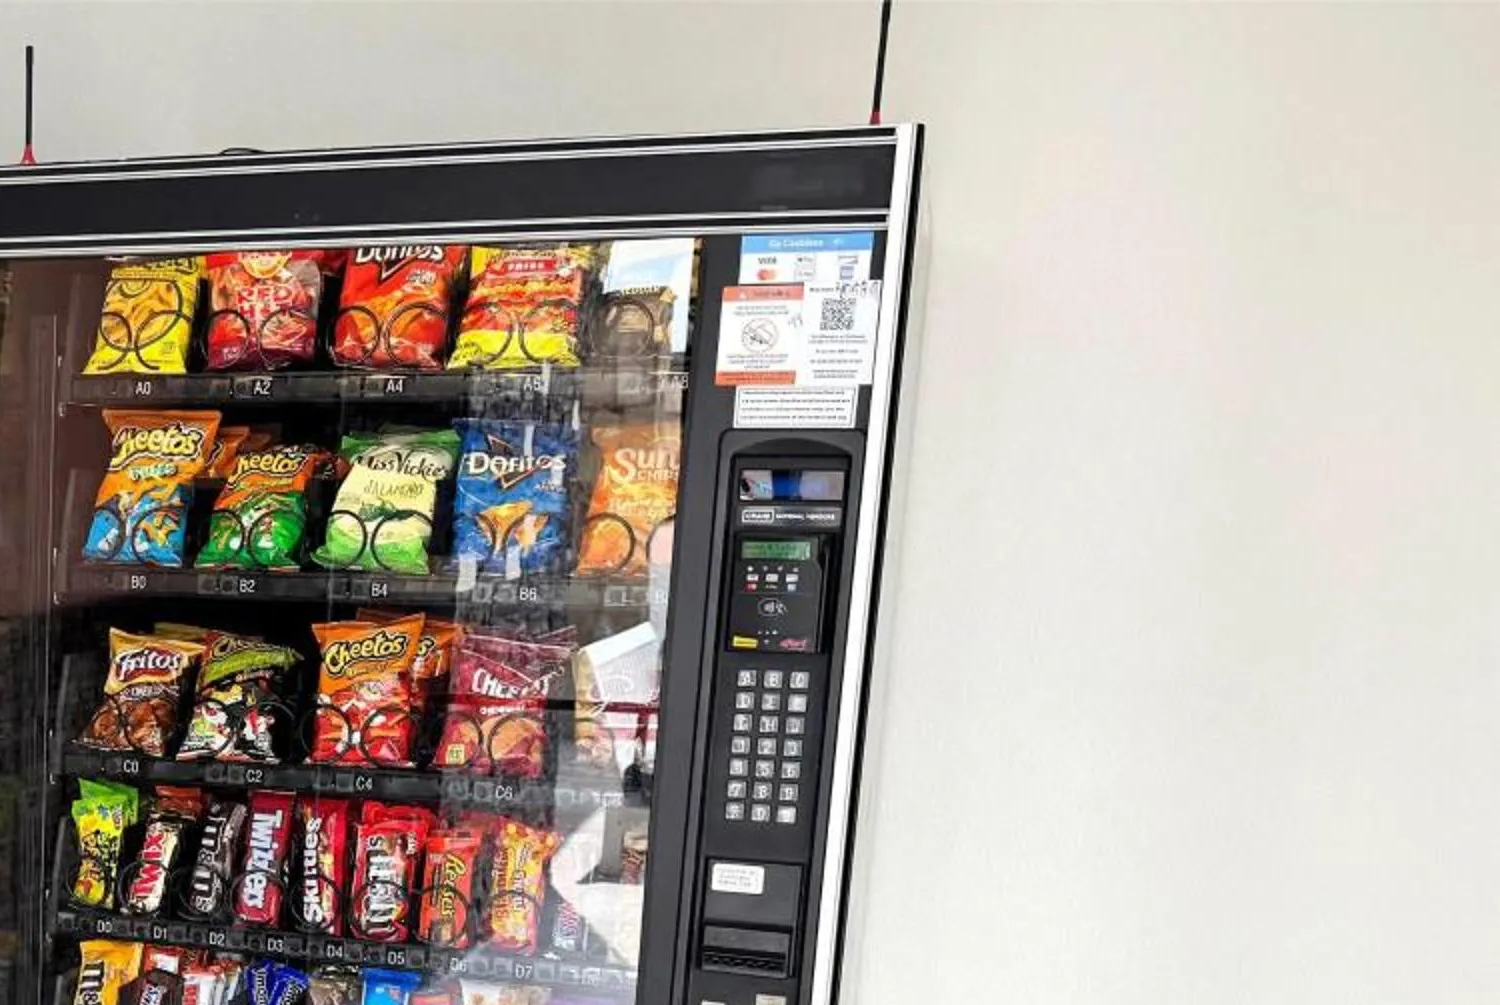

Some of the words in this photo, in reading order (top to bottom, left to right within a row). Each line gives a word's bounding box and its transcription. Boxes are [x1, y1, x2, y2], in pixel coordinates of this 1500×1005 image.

[135, 382, 151, 395] A0
[253, 382, 271, 395] A2
[385, 378, 403, 393] A4
[228, 453, 298, 484] heetos
[466, 450, 567, 475] Doritos
[132, 576, 147, 589] B0
[239, 579, 255, 593] B2
[371, 583, 388, 598] B4
[325, 631, 407, 675] Cheetos
[119, 648, 181, 681] Fritos
[123, 760, 139, 773] C0
[246, 769, 263, 782] C2
[356, 775, 373, 790] C4
[97, 921, 113, 933] D0
[153, 927, 168, 939] D1
[209, 932, 225, 946] D2
[267, 939, 283, 952] D3
[326, 944, 343, 958] D4
[387, 951, 405, 965] D5
